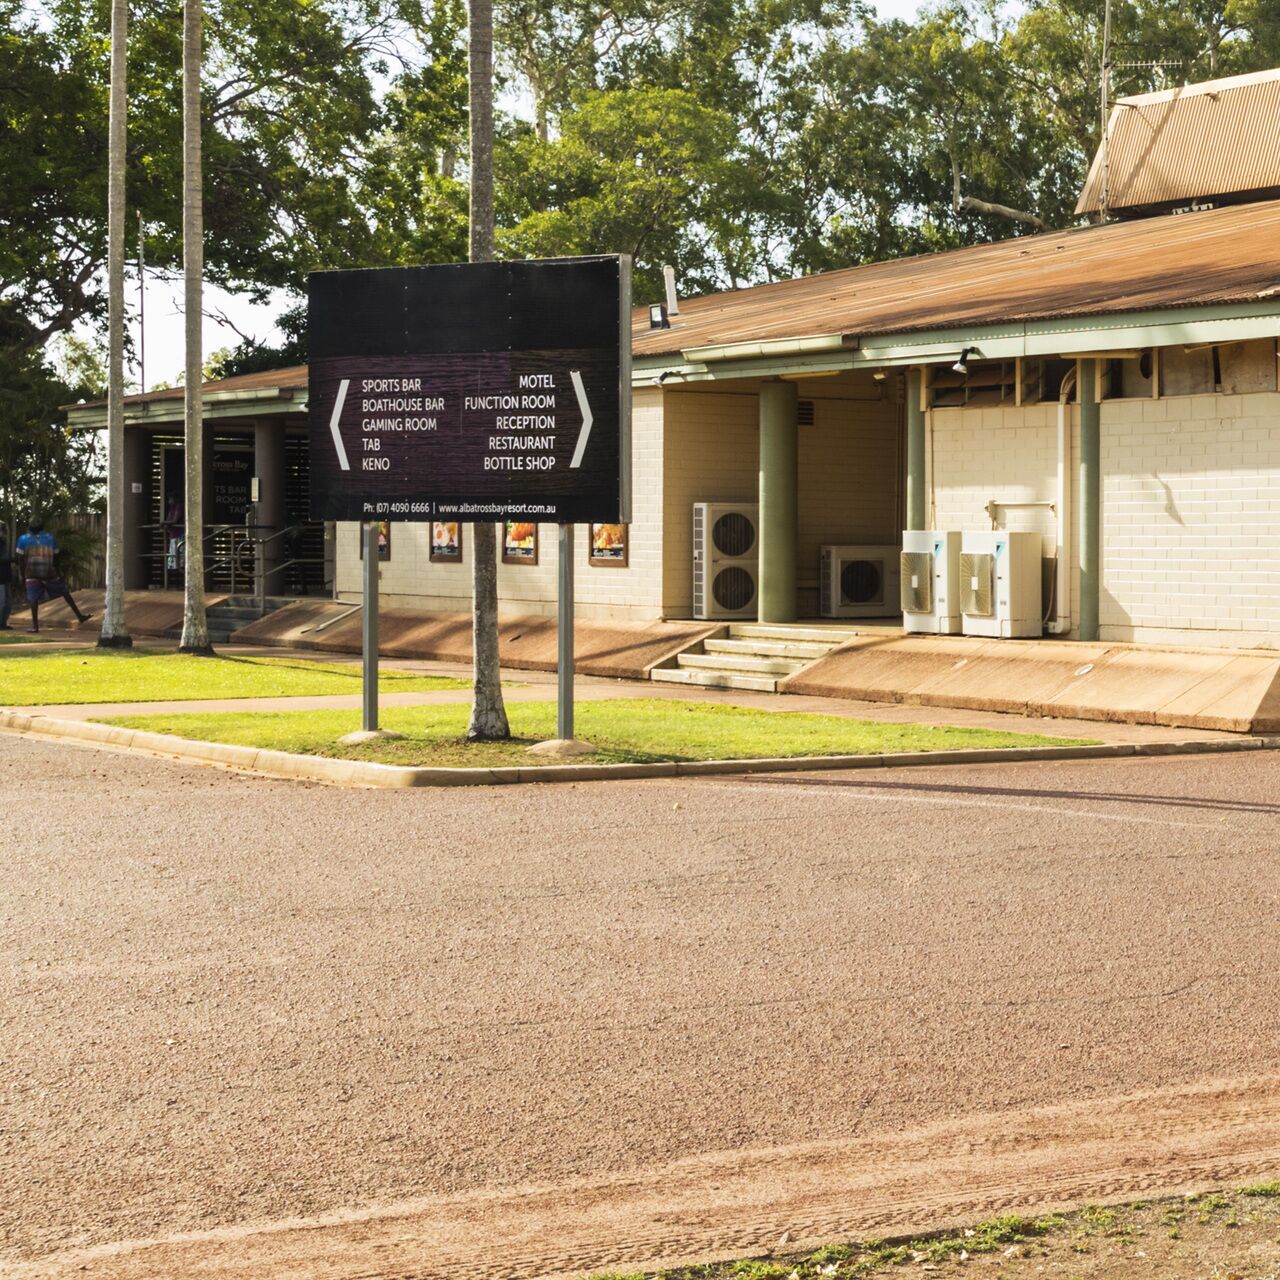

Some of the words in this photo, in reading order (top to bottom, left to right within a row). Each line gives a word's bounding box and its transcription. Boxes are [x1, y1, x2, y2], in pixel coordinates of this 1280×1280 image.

[362, 379, 400, 392] SPORTS
[402, 378, 421, 391] BAR
[519, 374, 556, 388] MOTEL
[362, 398, 423, 412] BOATHOUSE
[425, 397, 445, 411] BAR
[464, 395, 519, 410] FUNCTION
[521, 394, 556, 409] ROOM
[362, 418, 403, 431] GAMING
[405, 417, 437, 431] ROOM
[496, 415, 556, 430] RECEPTION
[362, 438, 381, 451] TAB
[488, 435, 556, 450] RESTAURANT
[362, 457, 390, 470] KENO
[484, 456, 524, 470] BOTTLE
[525, 456, 556, 470] SHOP
[363, 502, 375, 513] Ph:
[376, 502, 389, 514] (07)
[390, 502, 409, 513] 4090
[411, 502, 430, 513] 6666
[438, 502, 556, 515] www.albatrossbayresort.com.au
